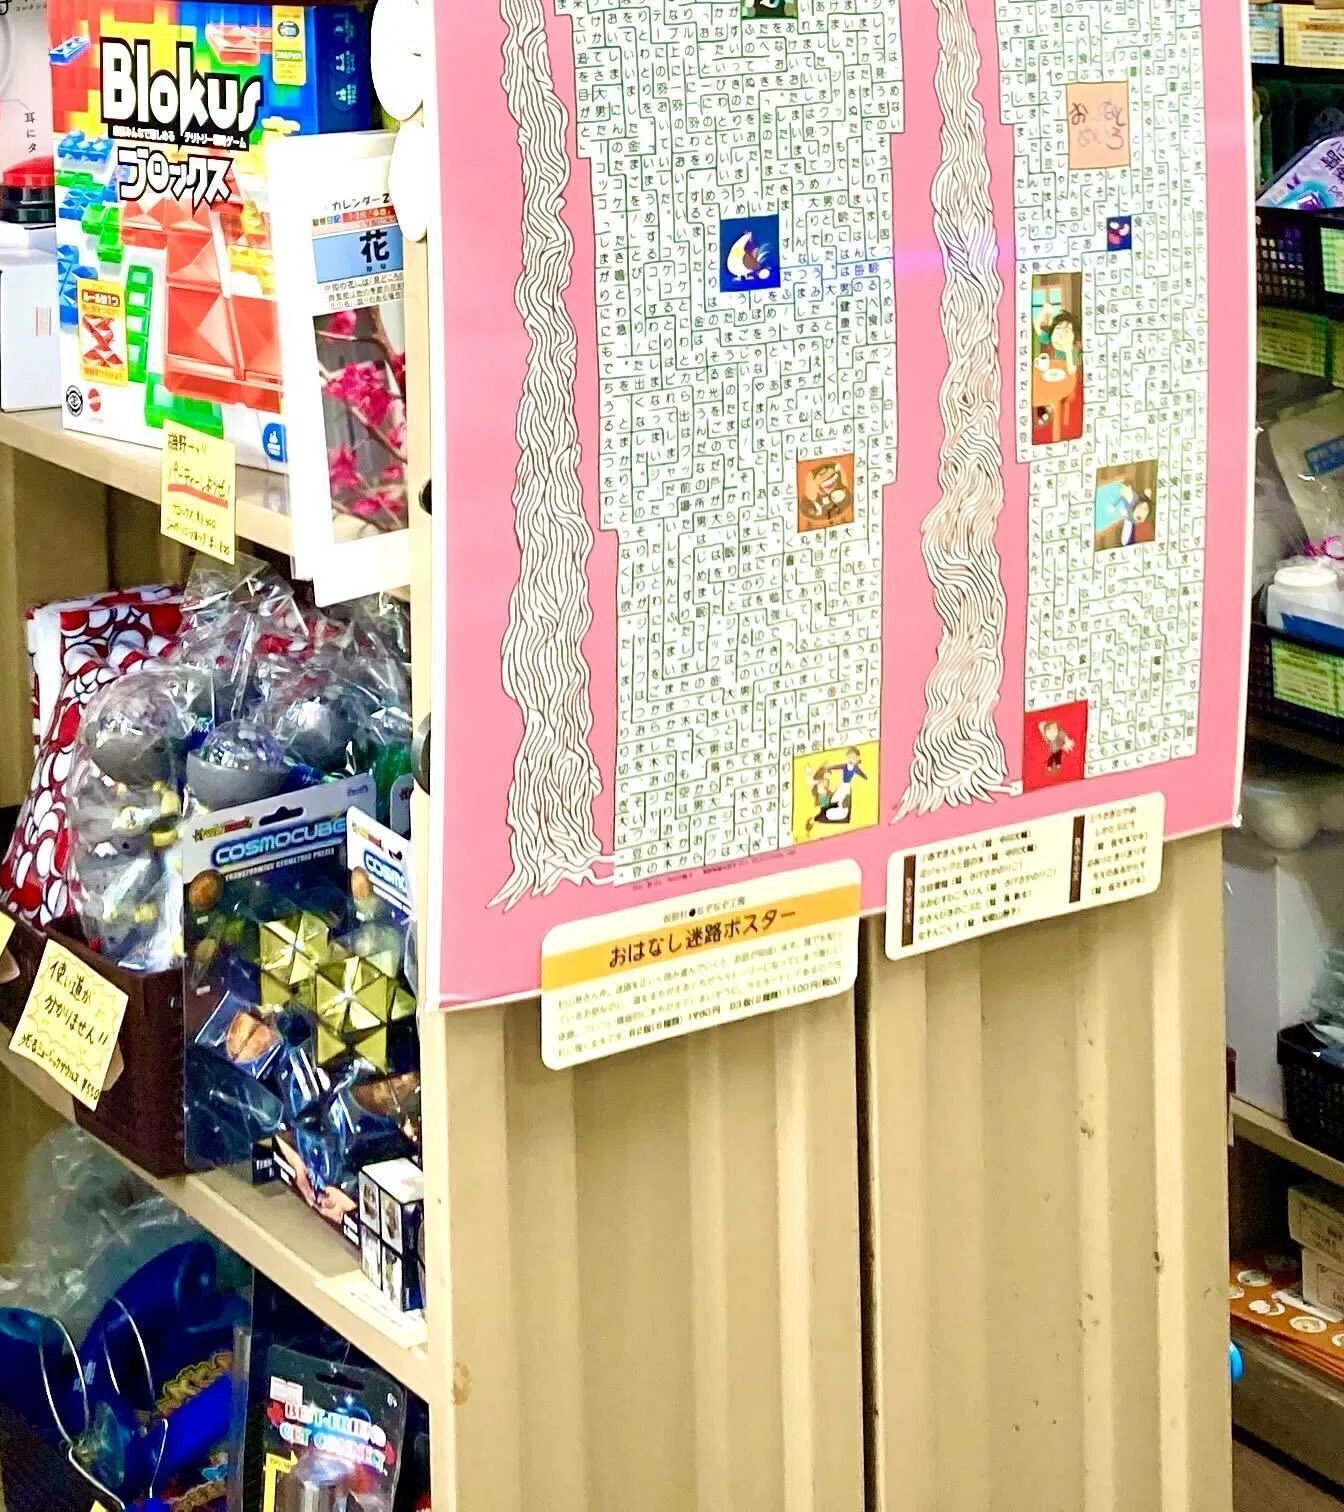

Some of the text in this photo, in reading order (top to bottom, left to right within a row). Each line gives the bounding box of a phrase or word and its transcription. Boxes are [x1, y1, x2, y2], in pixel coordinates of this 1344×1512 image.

[101, 38, 262, 138] Blokus
[118, 145, 233, 213] ブロックス
[359, 228, 391, 264] 花
[608, 908, 796, 971] おはなし迷路ポスター
